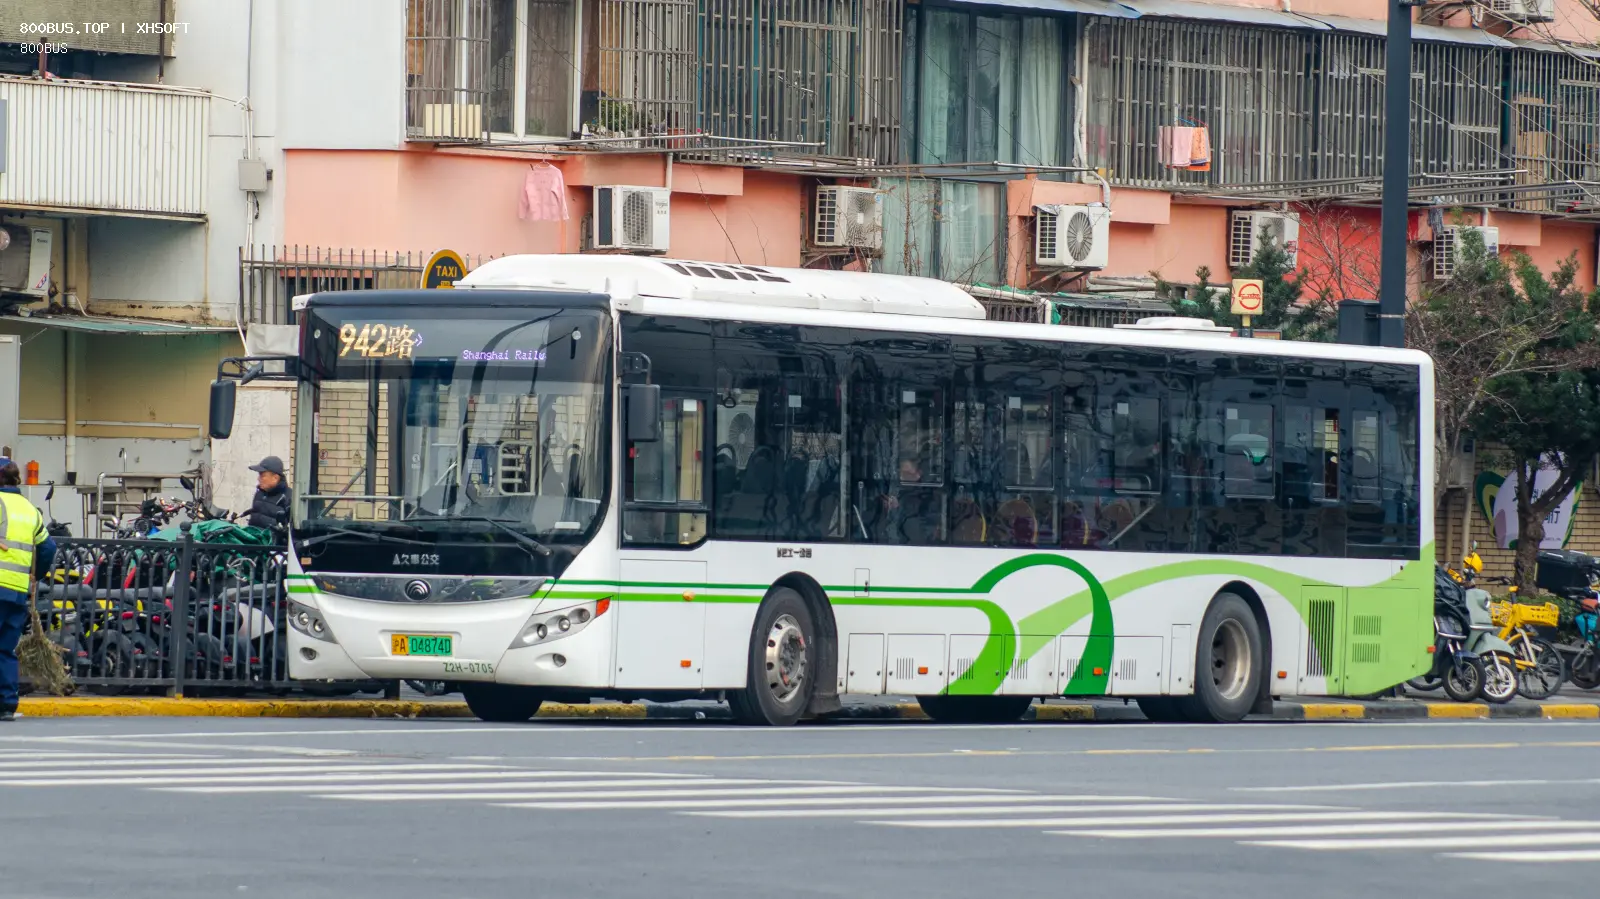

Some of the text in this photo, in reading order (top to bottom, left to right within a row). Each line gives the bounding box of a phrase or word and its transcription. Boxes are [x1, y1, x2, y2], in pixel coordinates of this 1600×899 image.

[436, 265, 458, 278] TAXI
[339, 323, 415, 359] 942路
[462, 349, 509, 361] Shanghai
[443, 662, 494, 674] Z2H-0705
